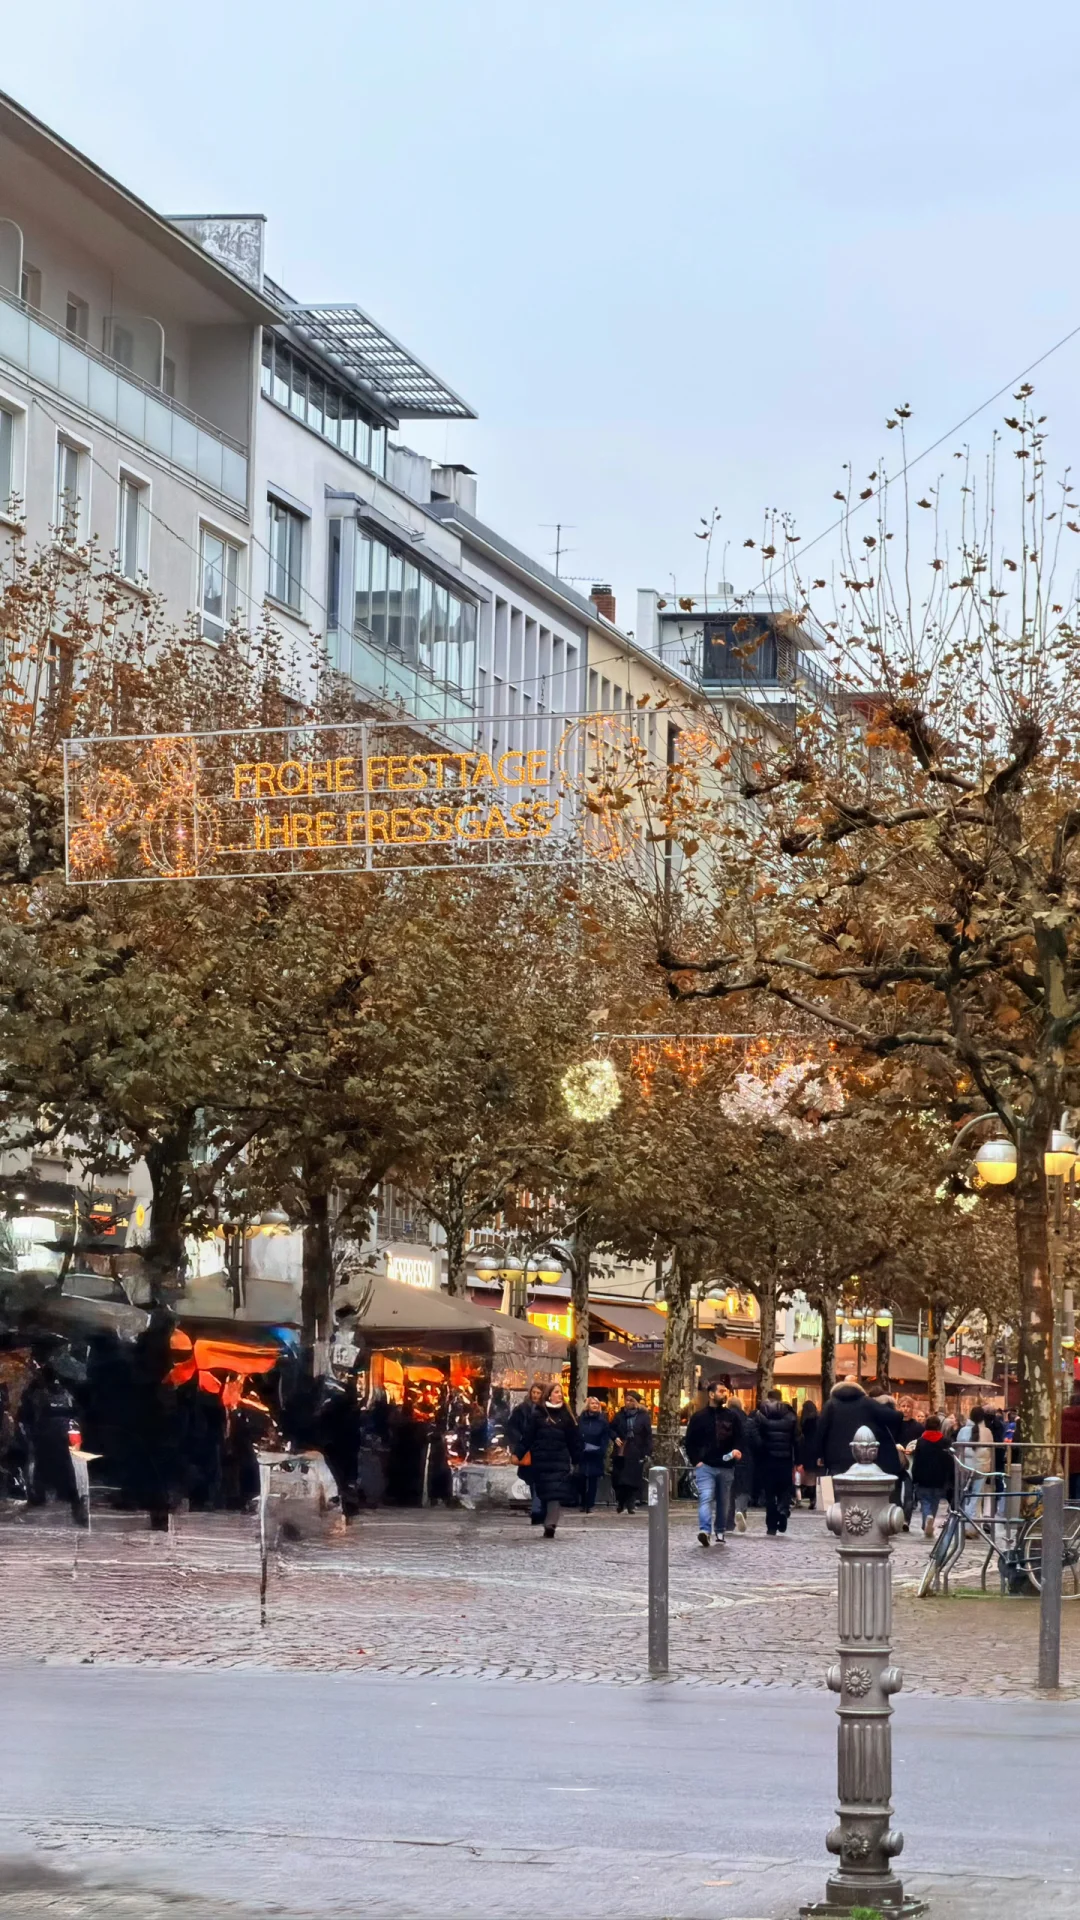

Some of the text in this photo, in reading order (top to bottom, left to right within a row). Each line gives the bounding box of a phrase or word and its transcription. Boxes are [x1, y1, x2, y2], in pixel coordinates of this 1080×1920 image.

[234, 749, 548, 800] FROHE FESTTAGE
[254, 811, 337, 850] IHRE
[386, 1252, 433, 1288] NESPRESSO
